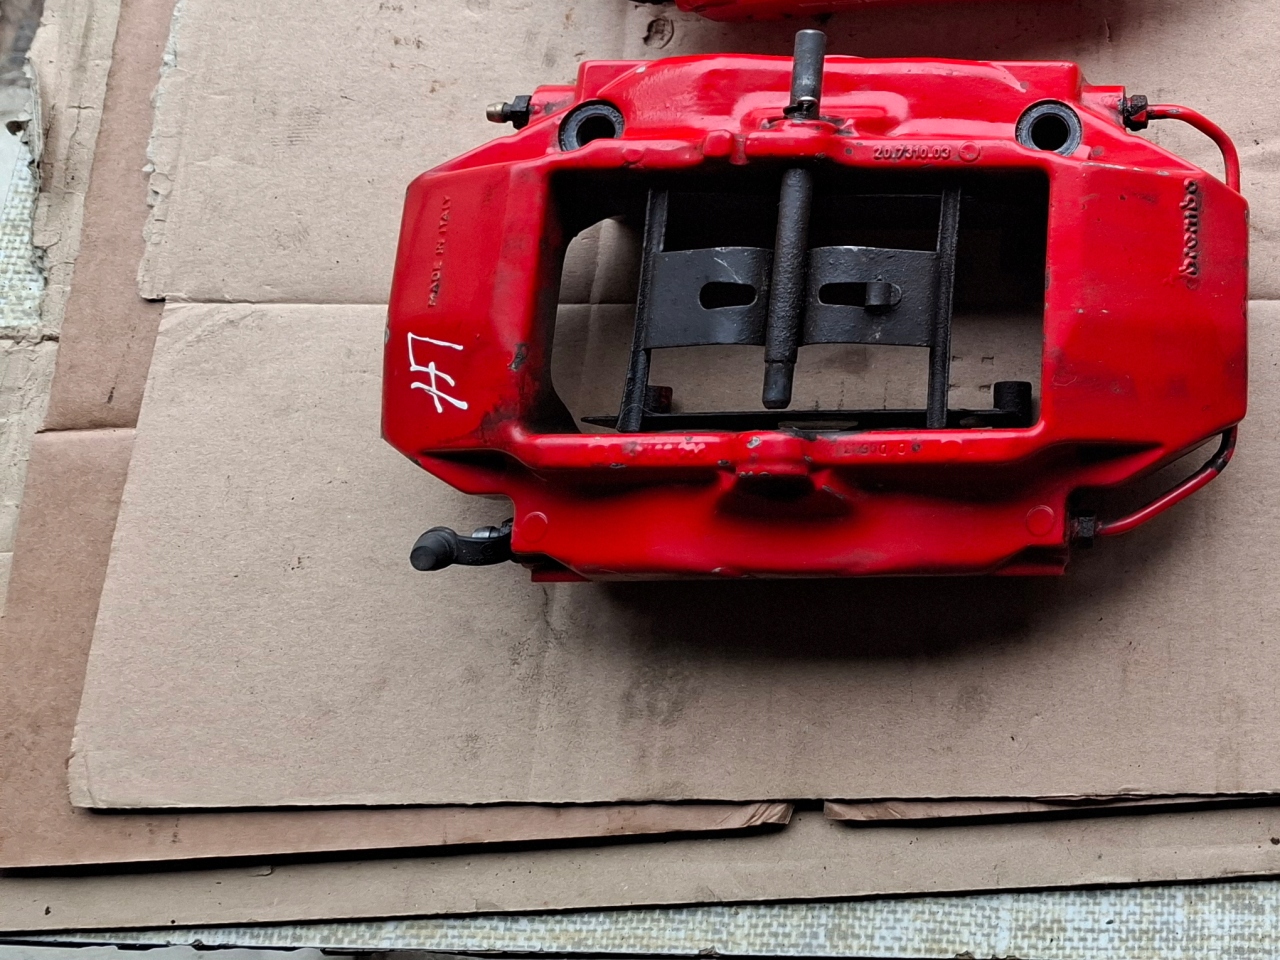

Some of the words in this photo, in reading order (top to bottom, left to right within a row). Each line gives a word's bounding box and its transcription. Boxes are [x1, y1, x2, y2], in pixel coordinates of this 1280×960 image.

[873, 144, 951, 161] 20.7310.03
[427, 259, 443, 308] MADE
[438, 195, 451, 235] ITALY
[1179, 177, 1199, 277] brembo
[406, 331, 469, 414] LH
